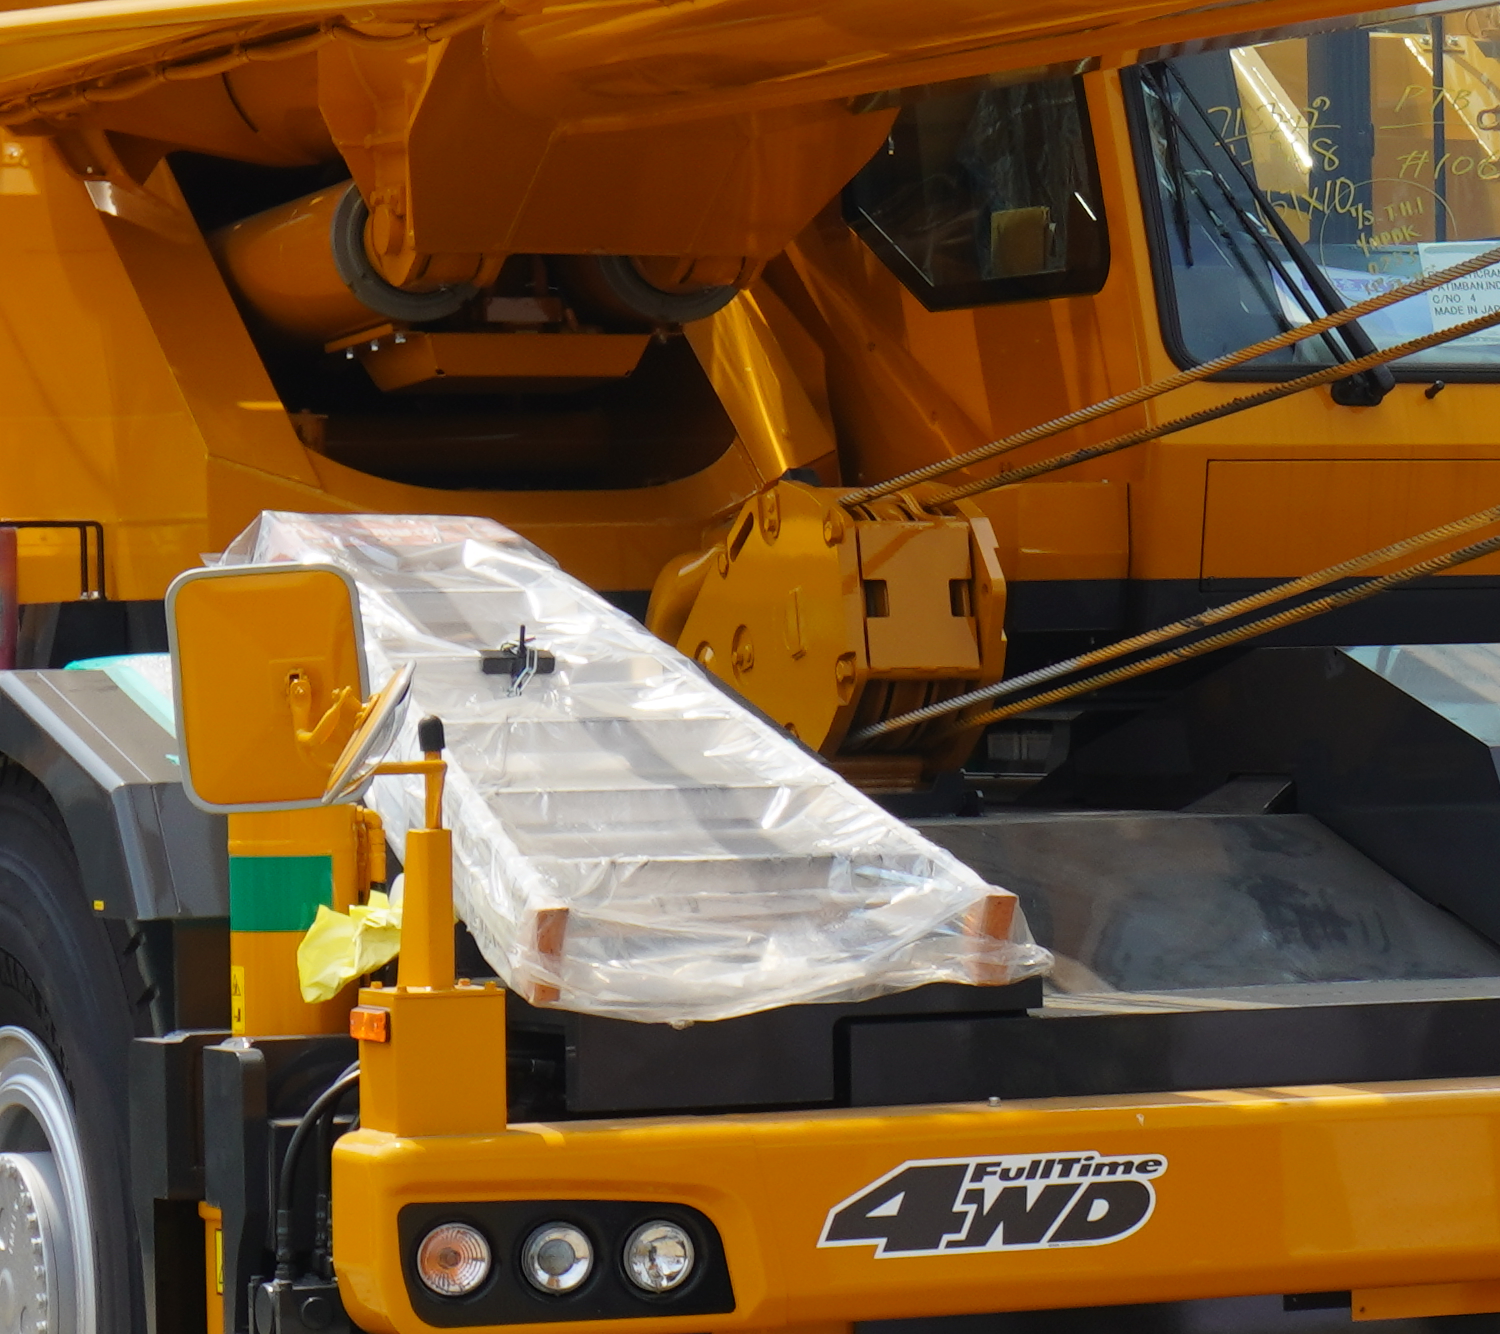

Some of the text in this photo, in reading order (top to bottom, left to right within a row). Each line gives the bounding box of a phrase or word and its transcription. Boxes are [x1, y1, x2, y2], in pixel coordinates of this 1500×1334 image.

[1434, 304, 1465, 316] MADE
[1467, 304, 1478, 315] IN
[969, 1155, 1164, 1184] FullTime
[824, 1162, 1151, 1253] 4WD
